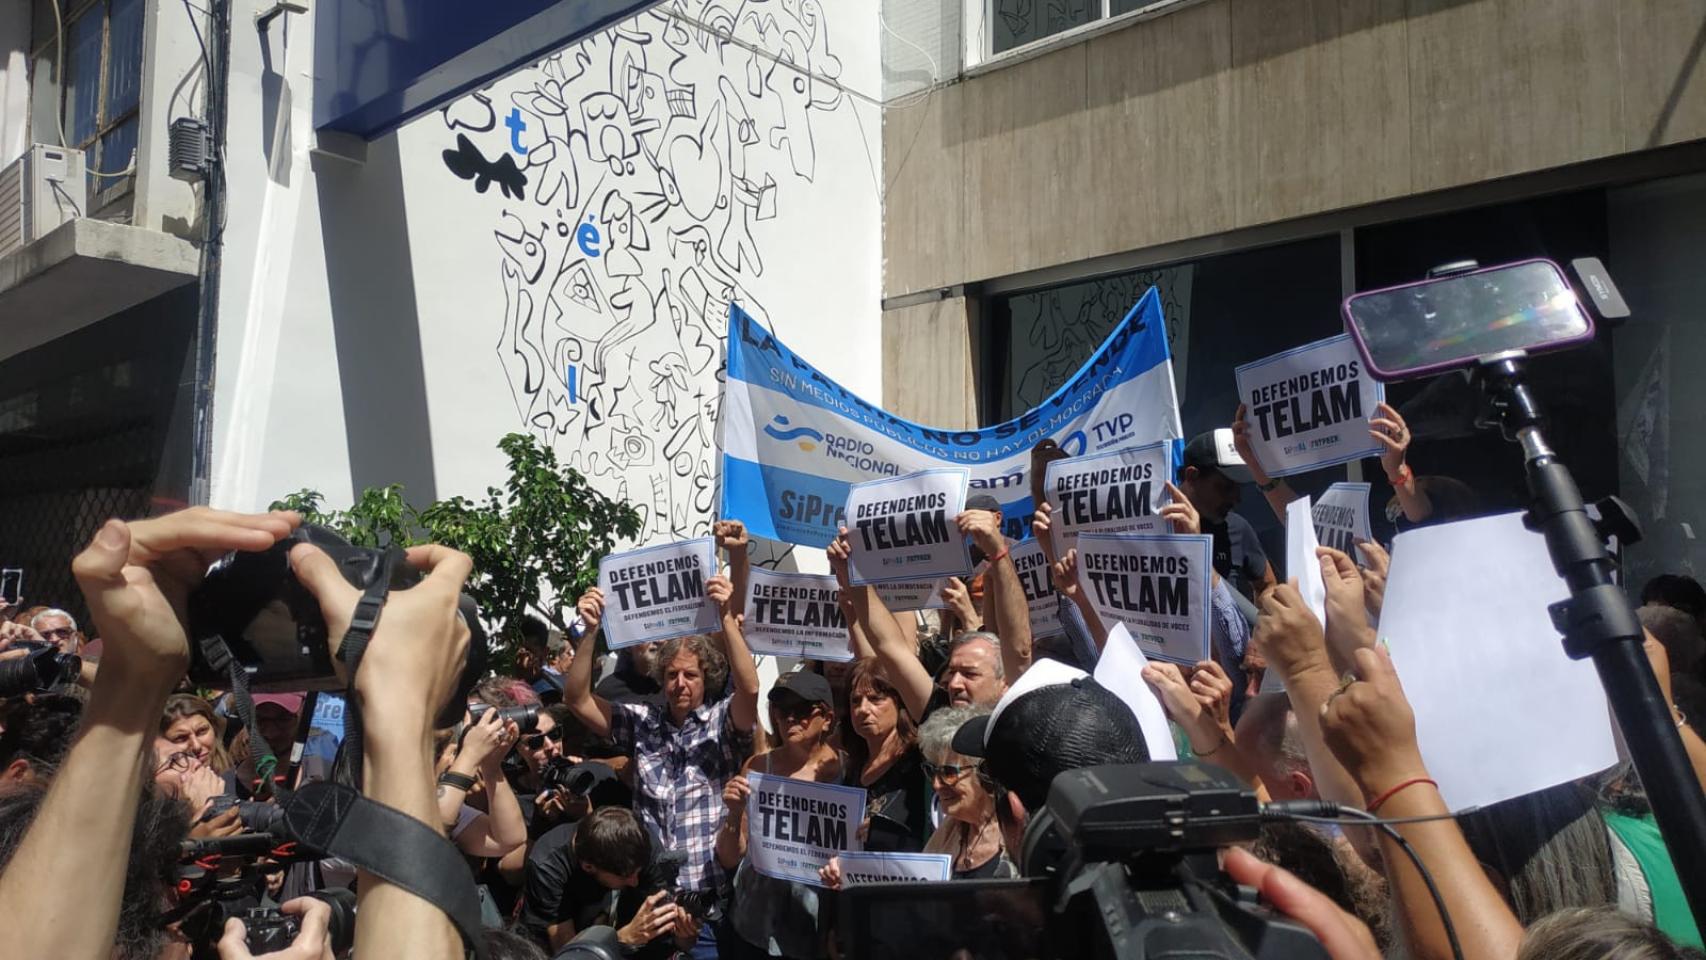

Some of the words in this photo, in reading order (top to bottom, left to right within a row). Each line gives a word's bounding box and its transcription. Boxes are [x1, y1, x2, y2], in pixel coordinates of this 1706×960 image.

[742, 315, 783, 358] LA
[995, 409, 1040, 439] SE
[1252, 361, 1359, 406] DEFENDEMOS
[770, 367, 797, 389] SIN
[802, 381, 860, 418] MEDIOS
[954, 450, 980, 461] NO
[986, 438, 1024, 459] HAY
[1092, 412, 1133, 442] TVP
[1254, 380, 1362, 442] TELAM
[825, 433, 874, 456] RADIO
[967, 470, 1024, 489] am
[1057, 463, 1153, 492] DEFENDEMOS
[778, 489, 845, 528] SiPre
[857, 492, 946, 519] DEFENDEMOS
[1058, 481, 1153, 526] TELAM
[1312, 504, 1355, 528] EFENDEMOS
[856, 509, 950, 552] TELAM
[609, 554, 700, 584] DEFENDEMOS
[1085, 553, 1189, 575] DEFENDEMOS
[611, 569, 704, 611] TELAM
[753, 583, 839, 603] DEFENDEMO
[1087, 572, 1190, 617] TELAM
[752, 597, 847, 629] TELAM
[758, 790, 847, 820] DEFENDEMOS
[759, 806, 848, 851] TELAM
